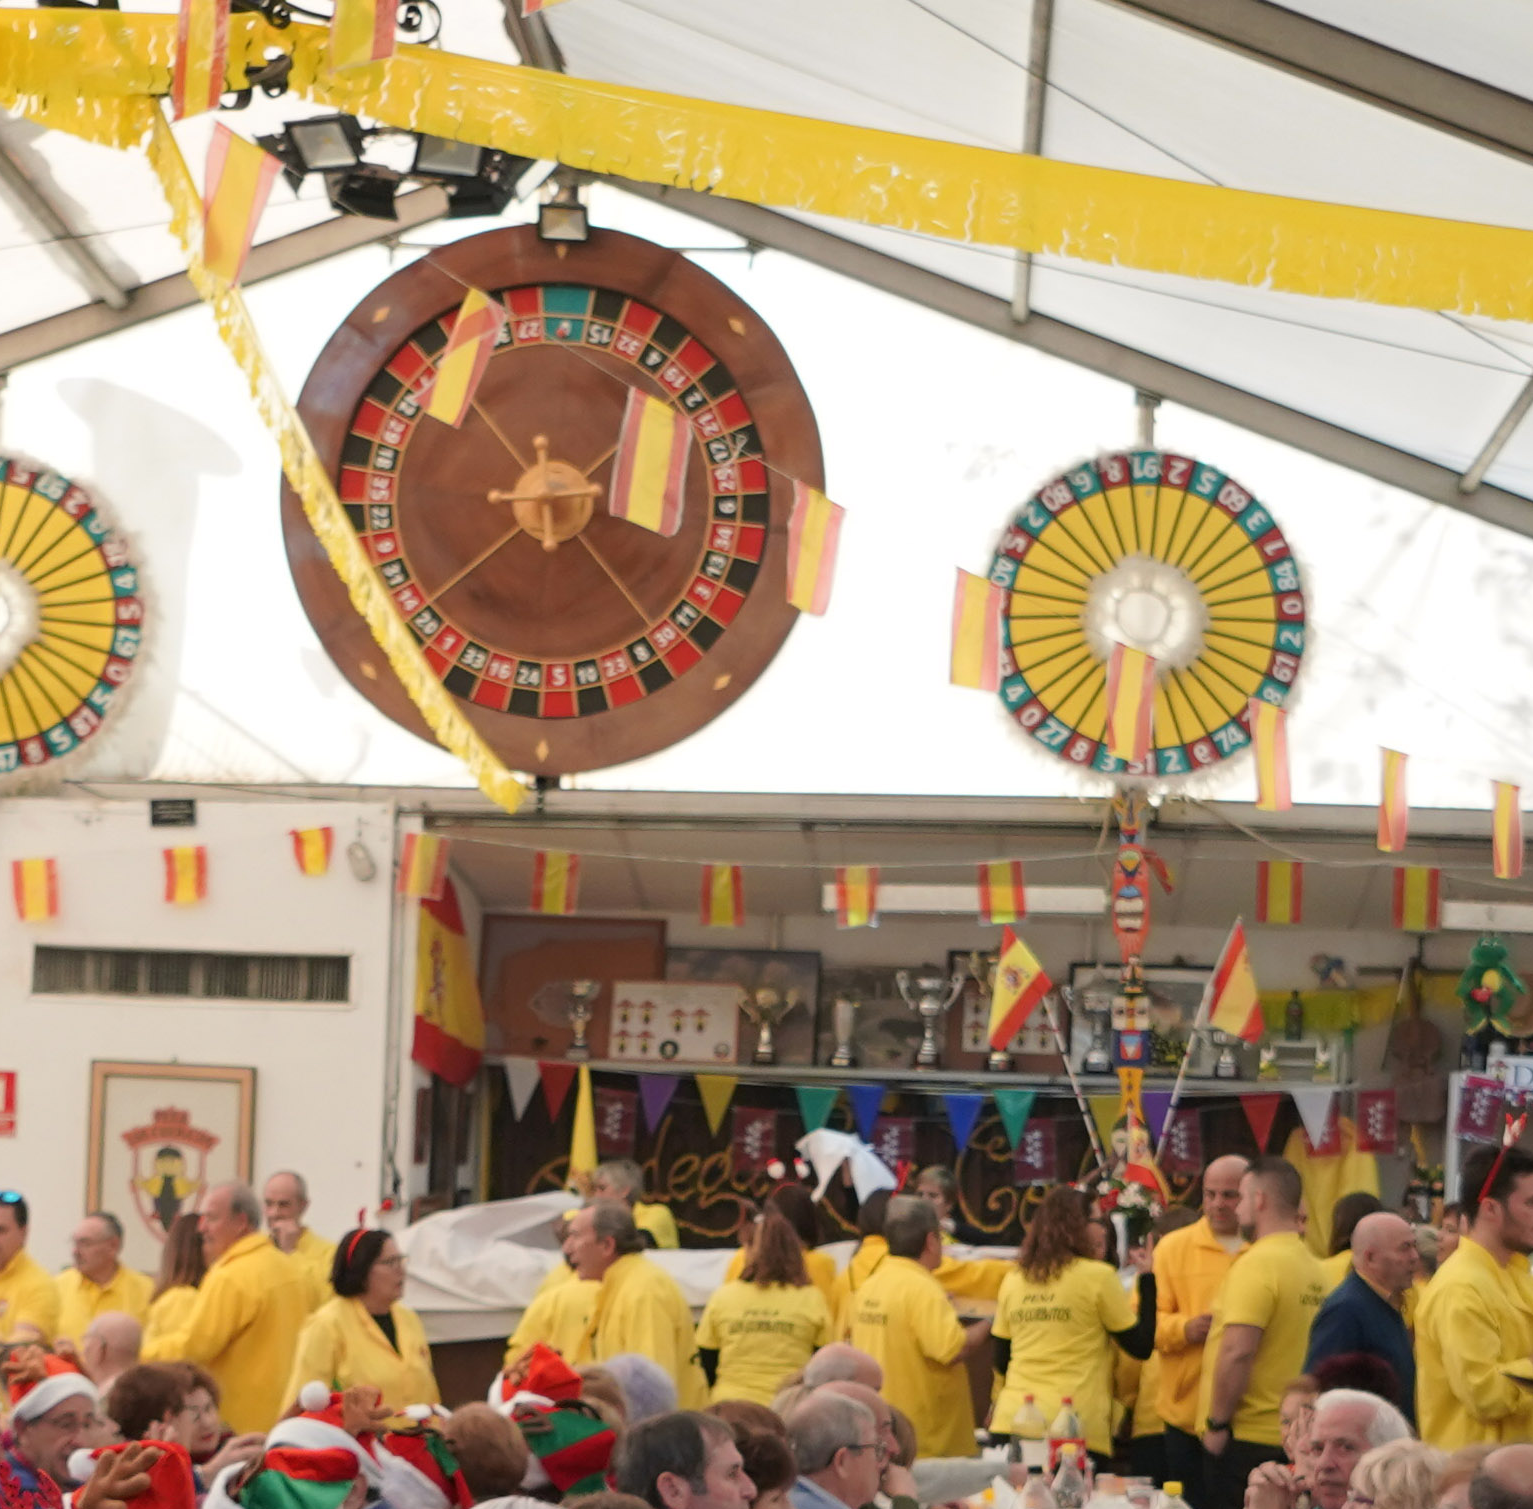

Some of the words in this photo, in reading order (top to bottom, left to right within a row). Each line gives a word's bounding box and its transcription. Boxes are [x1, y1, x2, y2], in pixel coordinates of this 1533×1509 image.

[684, 389, 702, 407] 2
[1168, 460, 1185, 484] 2
[1245, 509, 1267, 531] 3
[1281, 598, 1302, 615] 0
[440, 635, 455, 651] 1
[632, 640, 652, 660] 8
[603, 655, 627, 676] 23
[551, 667, 566, 685] 5
[1164, 751, 1181, 772] 2
